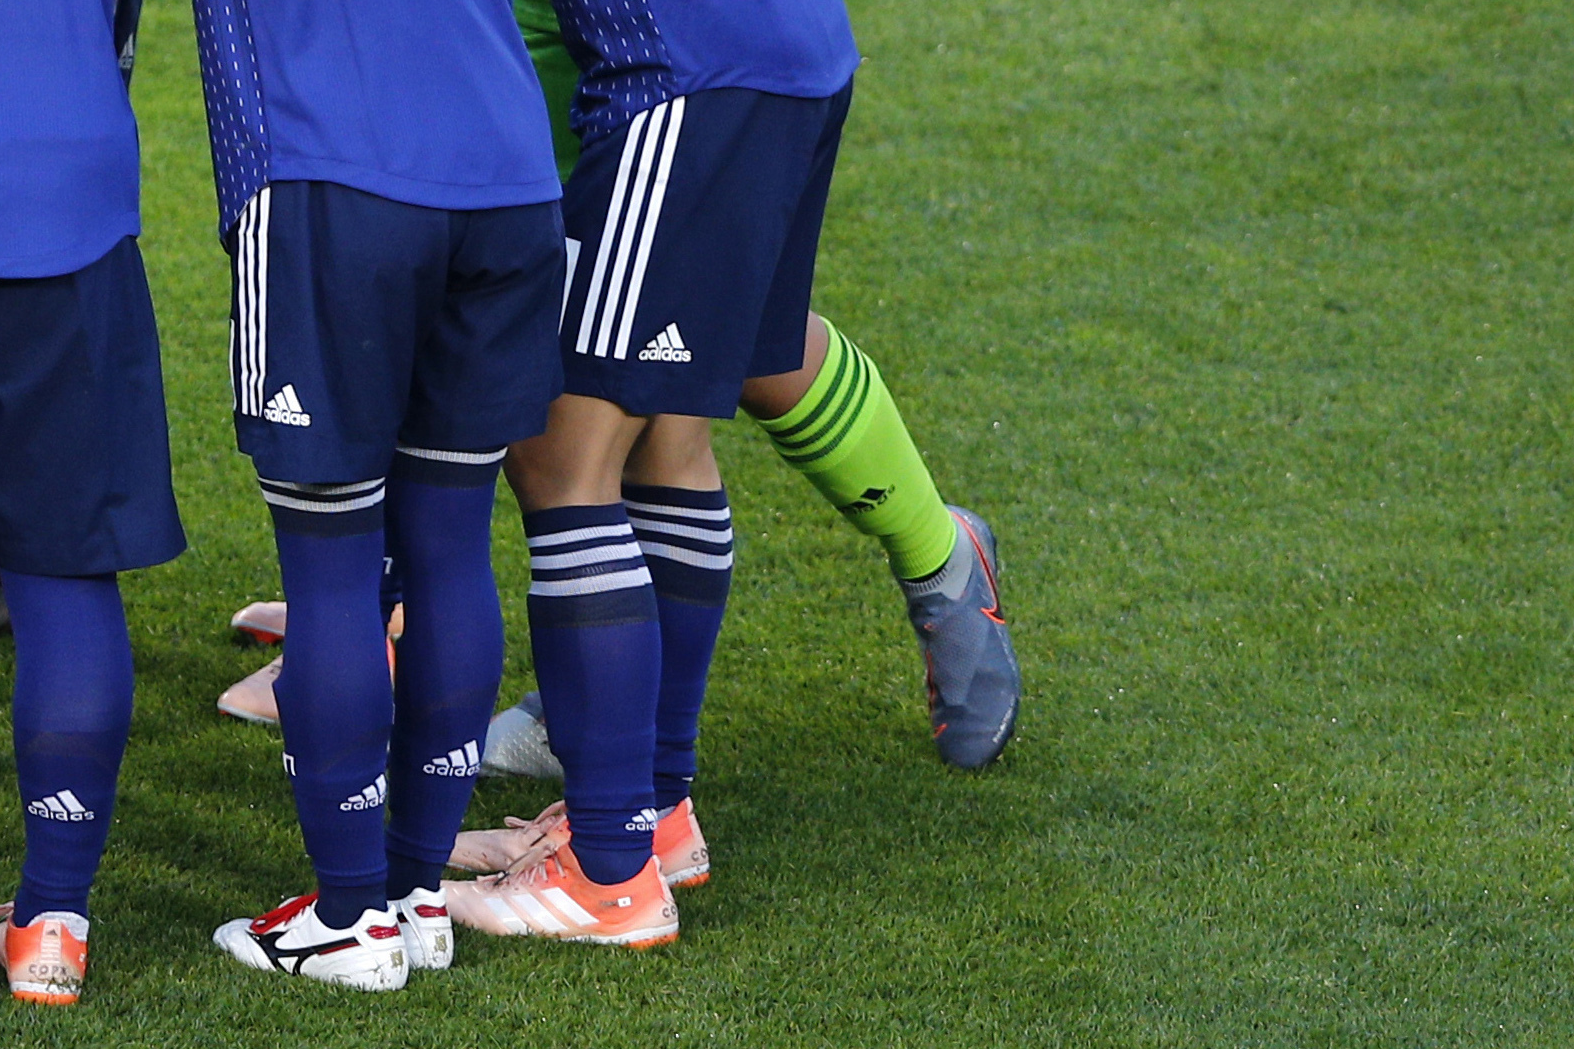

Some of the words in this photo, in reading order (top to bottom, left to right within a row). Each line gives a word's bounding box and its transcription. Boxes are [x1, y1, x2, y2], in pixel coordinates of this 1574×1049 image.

[638, 347, 692, 362] adidas
[263, 407, 311, 427] adidas
[27, 804, 95, 822] adidas
